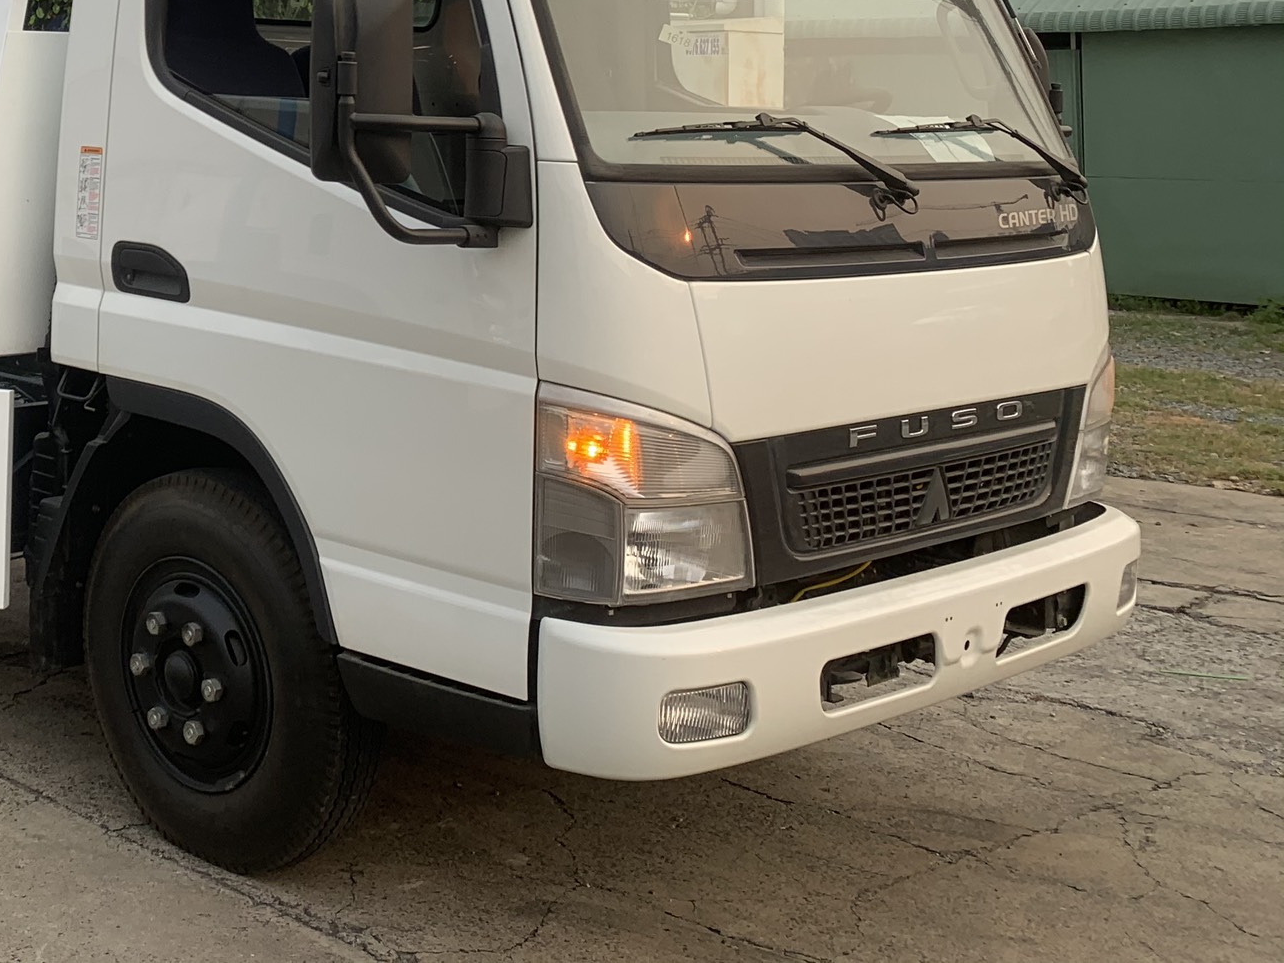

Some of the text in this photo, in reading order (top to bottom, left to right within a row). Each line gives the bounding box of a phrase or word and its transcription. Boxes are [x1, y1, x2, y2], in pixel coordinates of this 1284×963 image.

[999, 204, 1078, 228] CANTER HD
[849, 400, 1023, 448] FUSO
